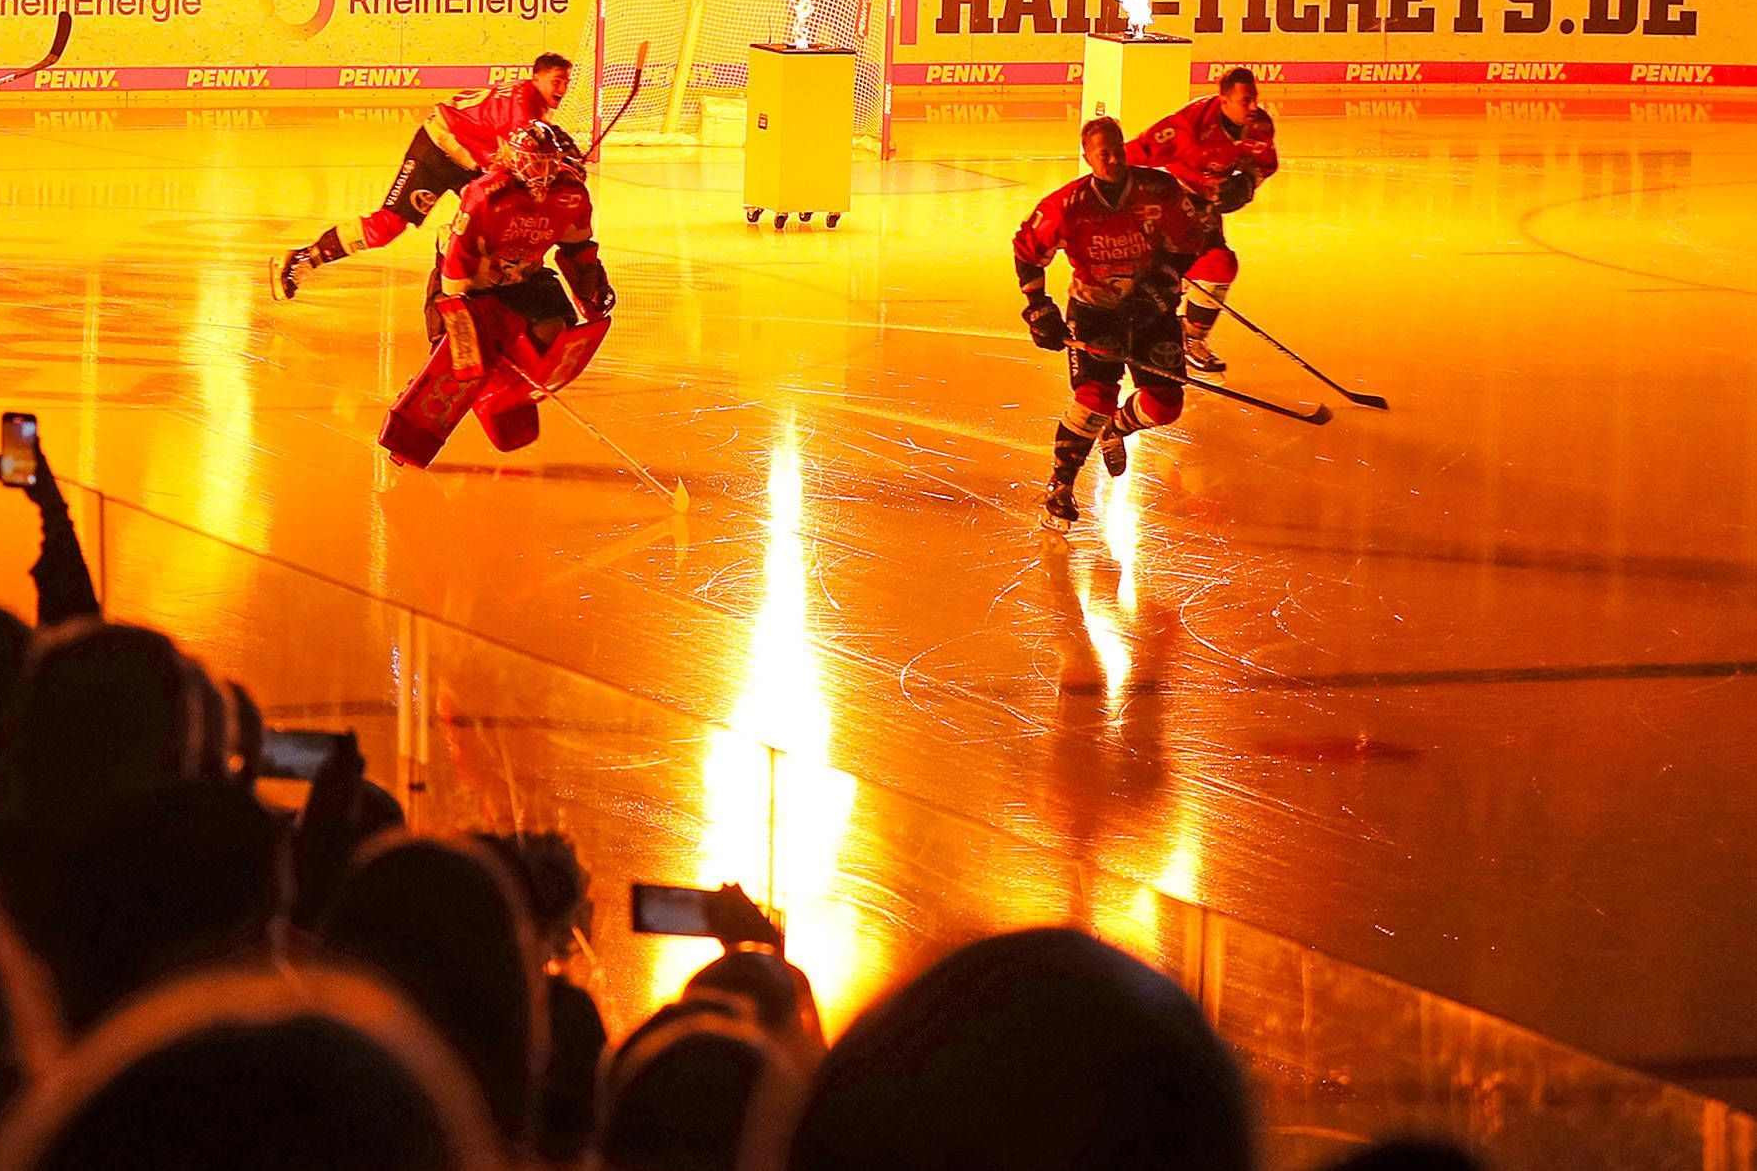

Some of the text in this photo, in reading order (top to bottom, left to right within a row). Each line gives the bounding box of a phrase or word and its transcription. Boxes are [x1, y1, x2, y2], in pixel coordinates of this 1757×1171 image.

[187, 68, 271, 87] PENNY.
[339, 67, 421, 86] PENNY.
[926, 64, 1005, 83] PENNY.
[1346, 64, 1423, 81] PENNY.
[1486, 63, 1566, 80] PENNY.
[1630, 64, 1714, 83] PENNY.
